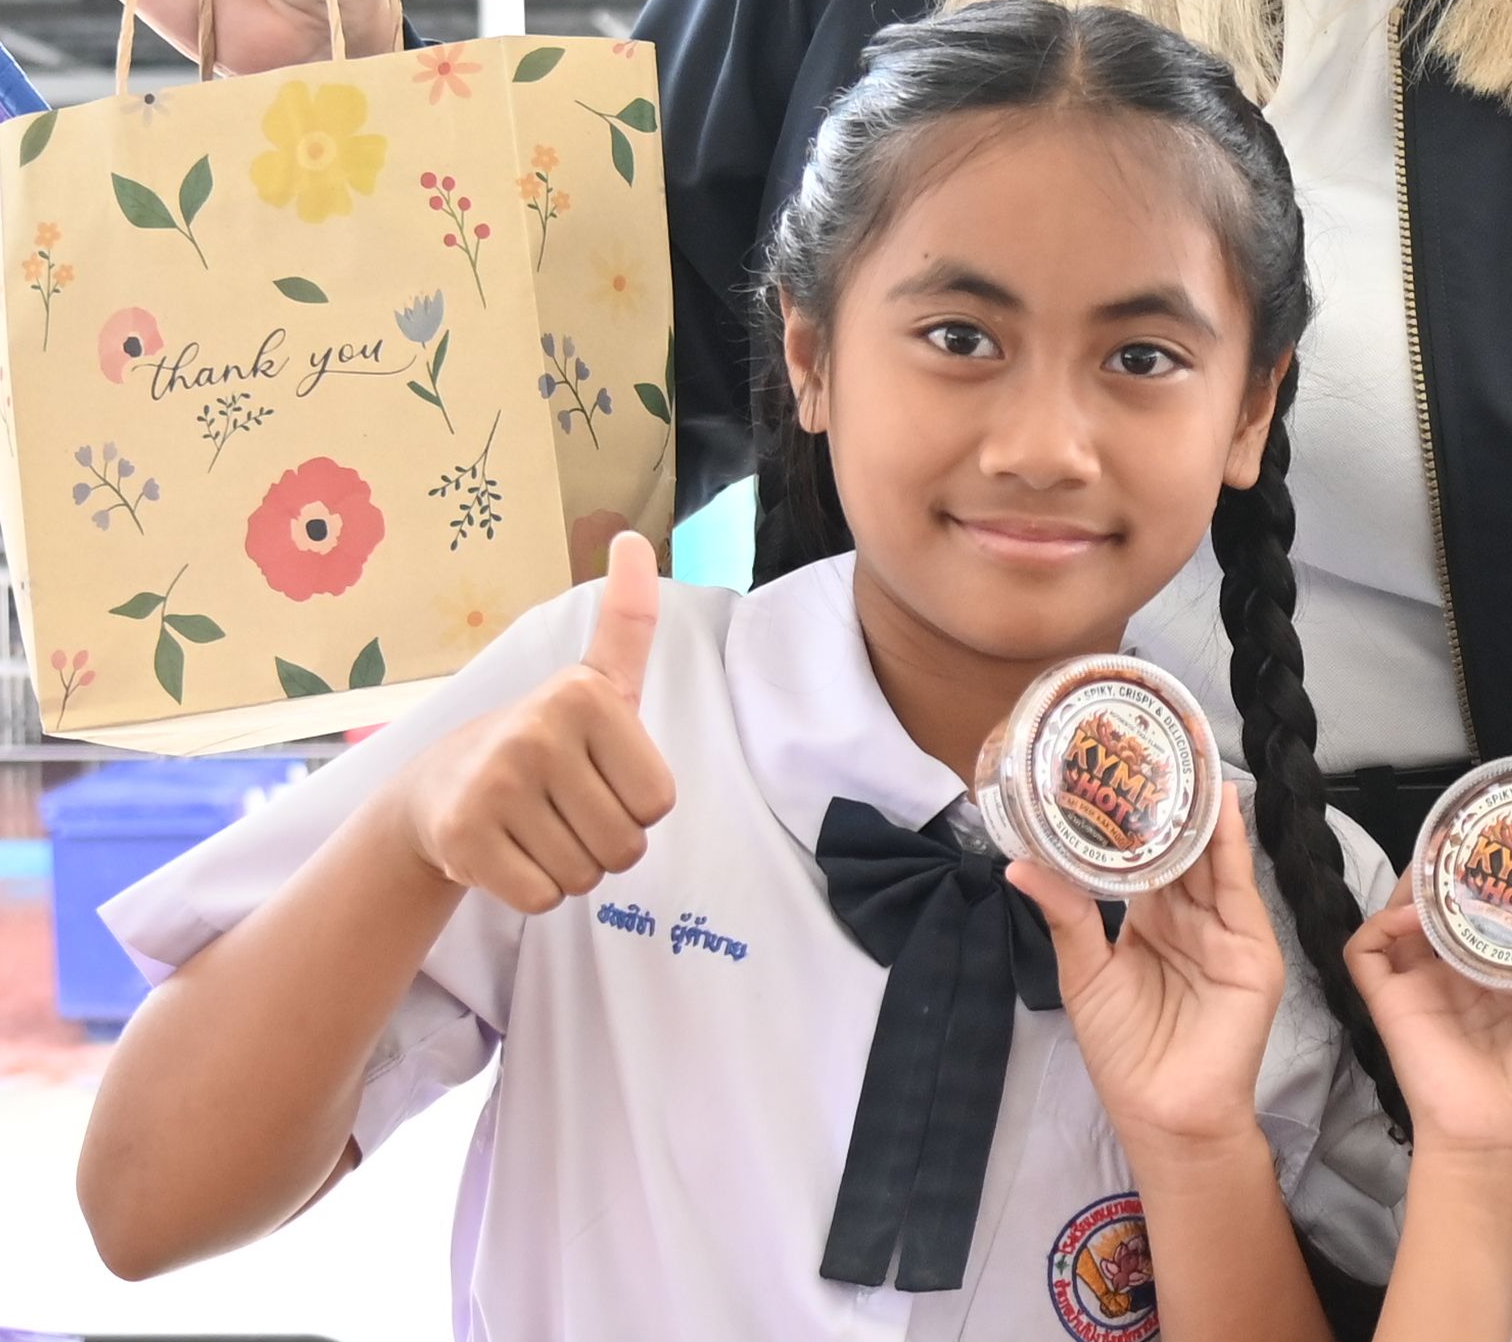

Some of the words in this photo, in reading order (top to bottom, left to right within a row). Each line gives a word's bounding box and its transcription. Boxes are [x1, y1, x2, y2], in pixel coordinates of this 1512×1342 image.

[128, 327, 291, 401] thank
[294, 338, 416, 398] you
[1084, 684, 1116, 700] SPIKY,
[1119, 685, 1156, 709] CRISPY
[1155, 706, 1164, 717] &
[1163, 716, 1193, 774] DELICIOUS
[1065, 728, 1169, 821] KYMK
[1077, 772, 1134, 826] HOT
[1056, 820, 1080, 849] SINCE
[1082, 845, 1108, 863] 2026
[1461, 927, 1490, 954] SINCE
